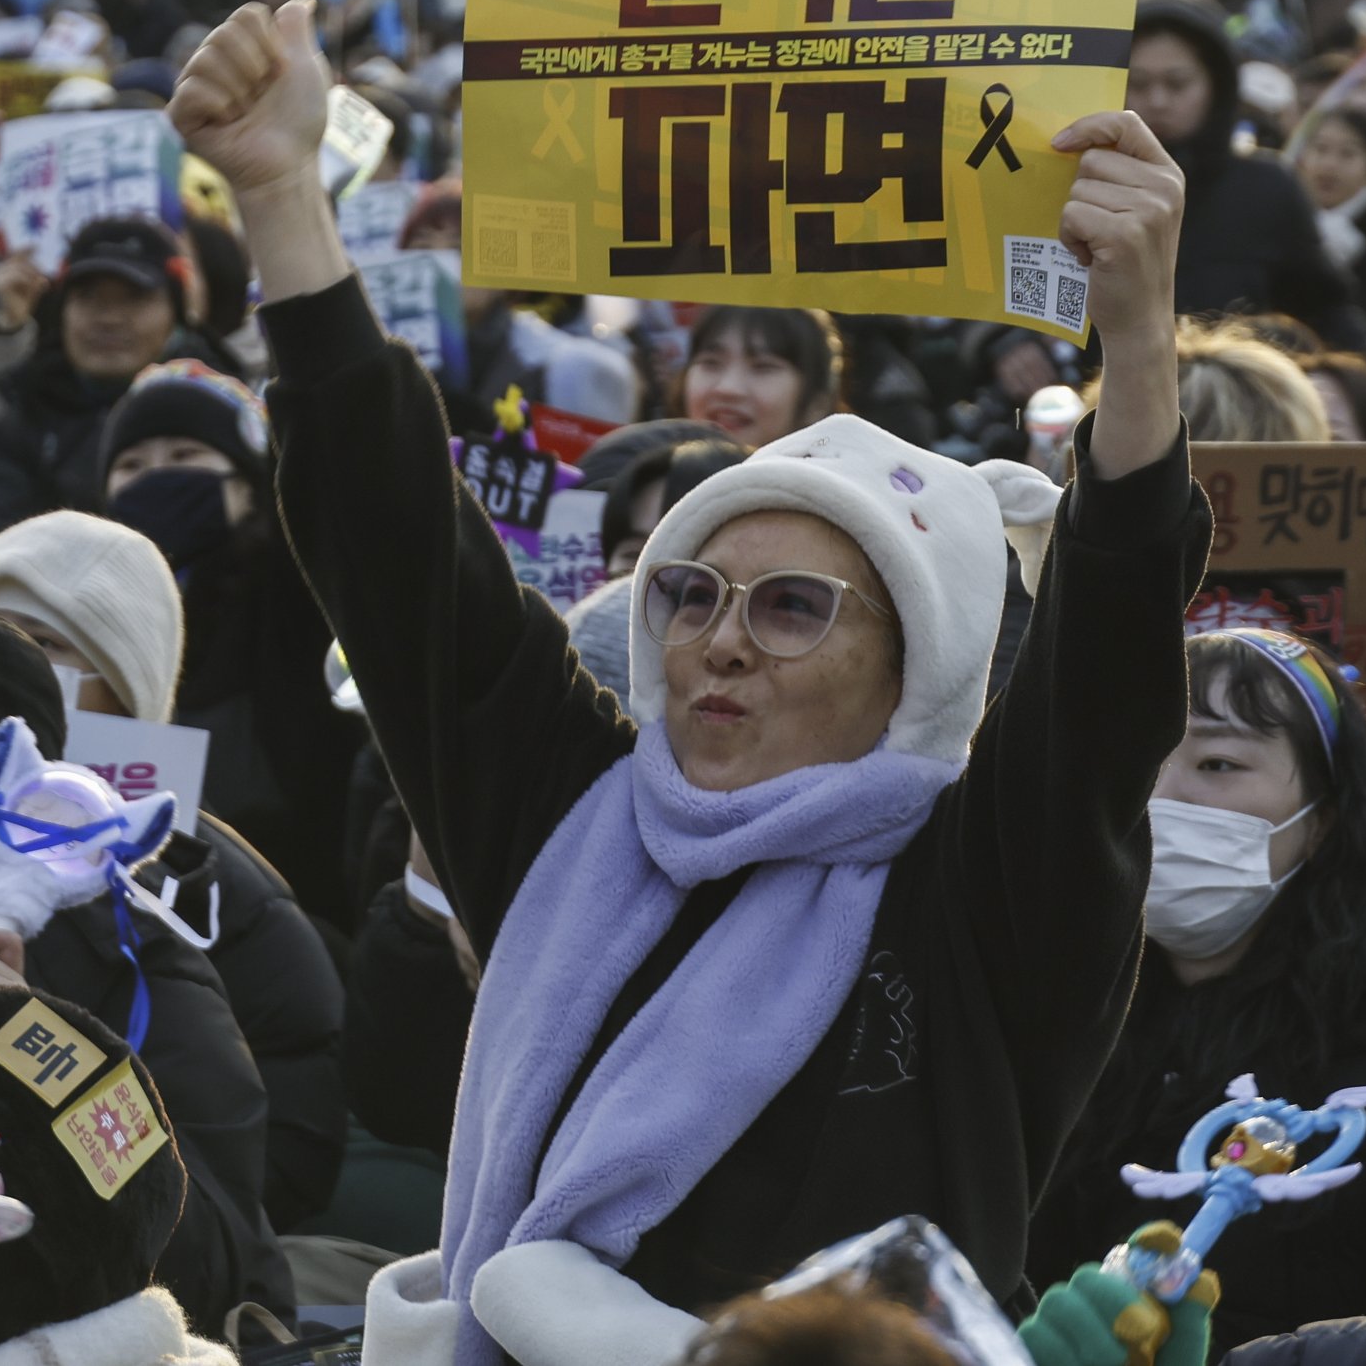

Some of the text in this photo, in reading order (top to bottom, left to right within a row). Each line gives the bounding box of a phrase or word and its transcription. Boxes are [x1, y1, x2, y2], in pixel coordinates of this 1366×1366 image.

[520, 32, 1073, 74] 국민에게 총구를 겨누는 정권에 안전을 맡길 수 없다
[608, 77, 949, 278] 파면
[113, 1083, 151, 1140] 윤석열
